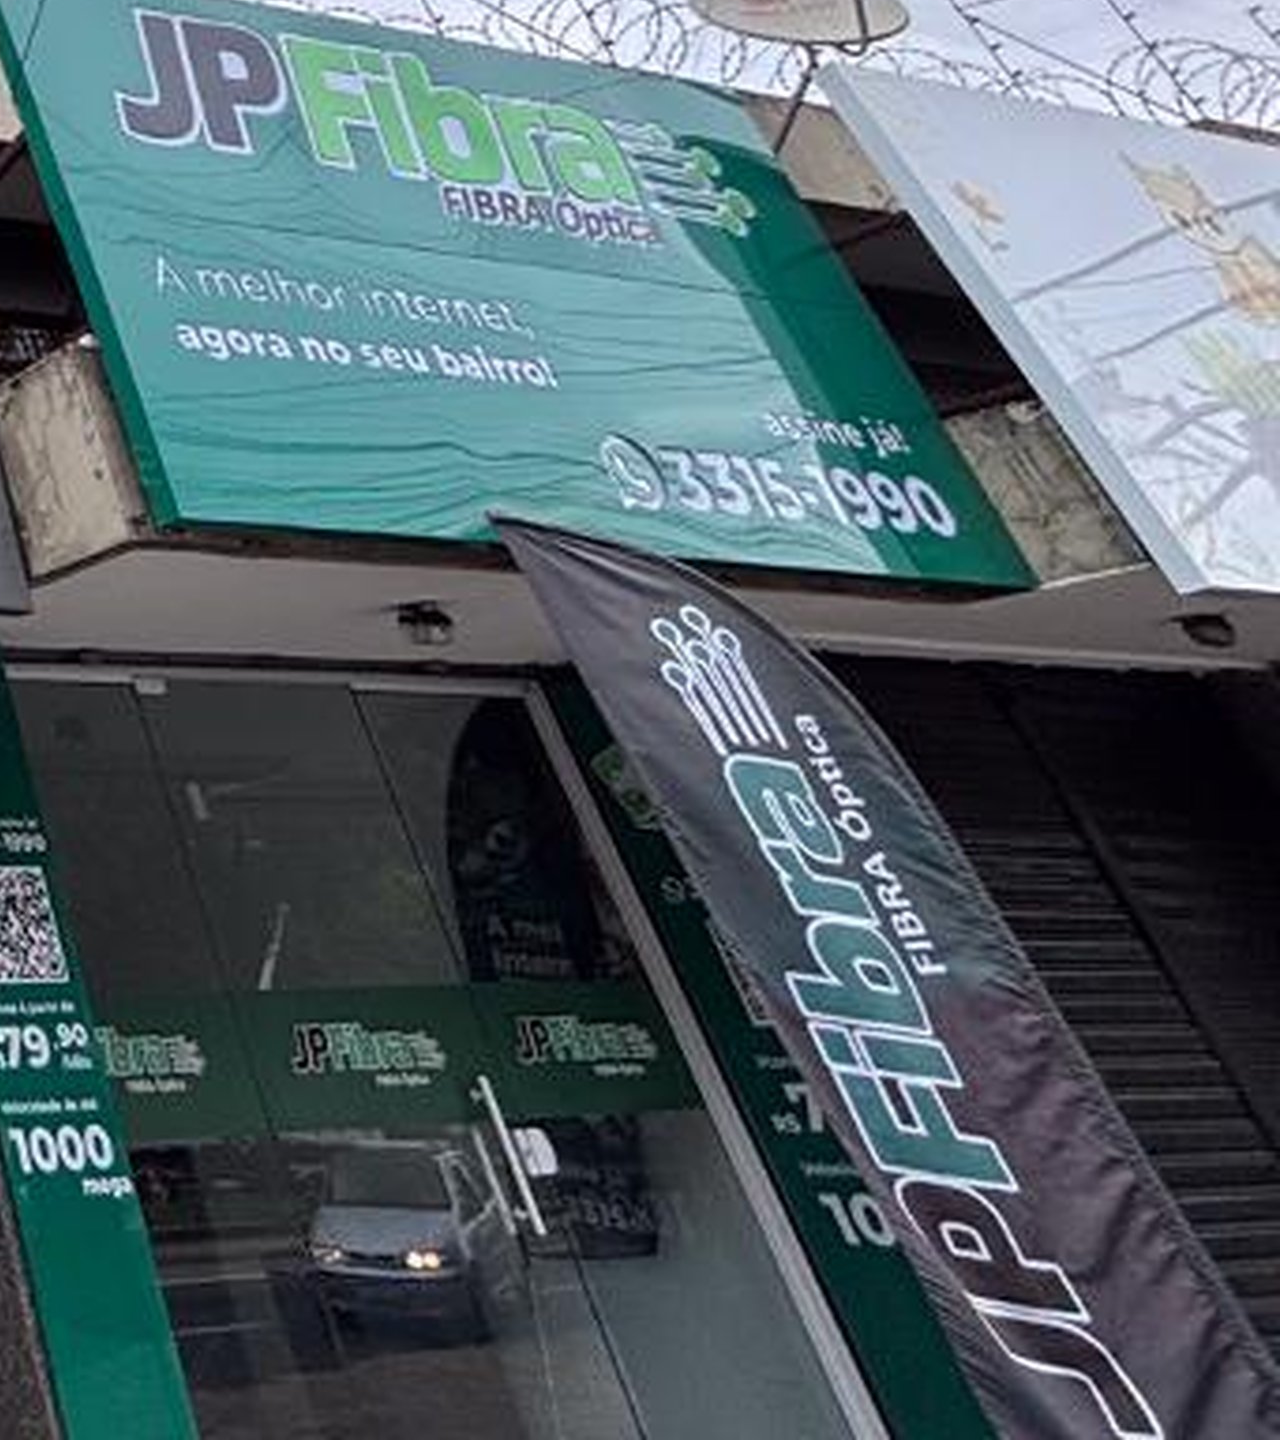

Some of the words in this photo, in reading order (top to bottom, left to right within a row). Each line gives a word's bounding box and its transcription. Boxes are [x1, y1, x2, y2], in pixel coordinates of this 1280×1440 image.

[443, 186, 550, 225] FIBRA
[157, 256, 188, 297] A
[195, 267, 346, 310] melhor
[355, 282, 536, 340] internet,
[177, 324, 292, 359] agora
[302, 337, 350, 365] no
[362, 348, 429, 373] seu
[434, 345, 558, 388] bairro!
[764, 411, 864, 449] assine
[657, 445, 957, 538] 3315-1990
[863, 851, 947, 976] FIBRA
[8, 1123, 115, 1175] 1000
